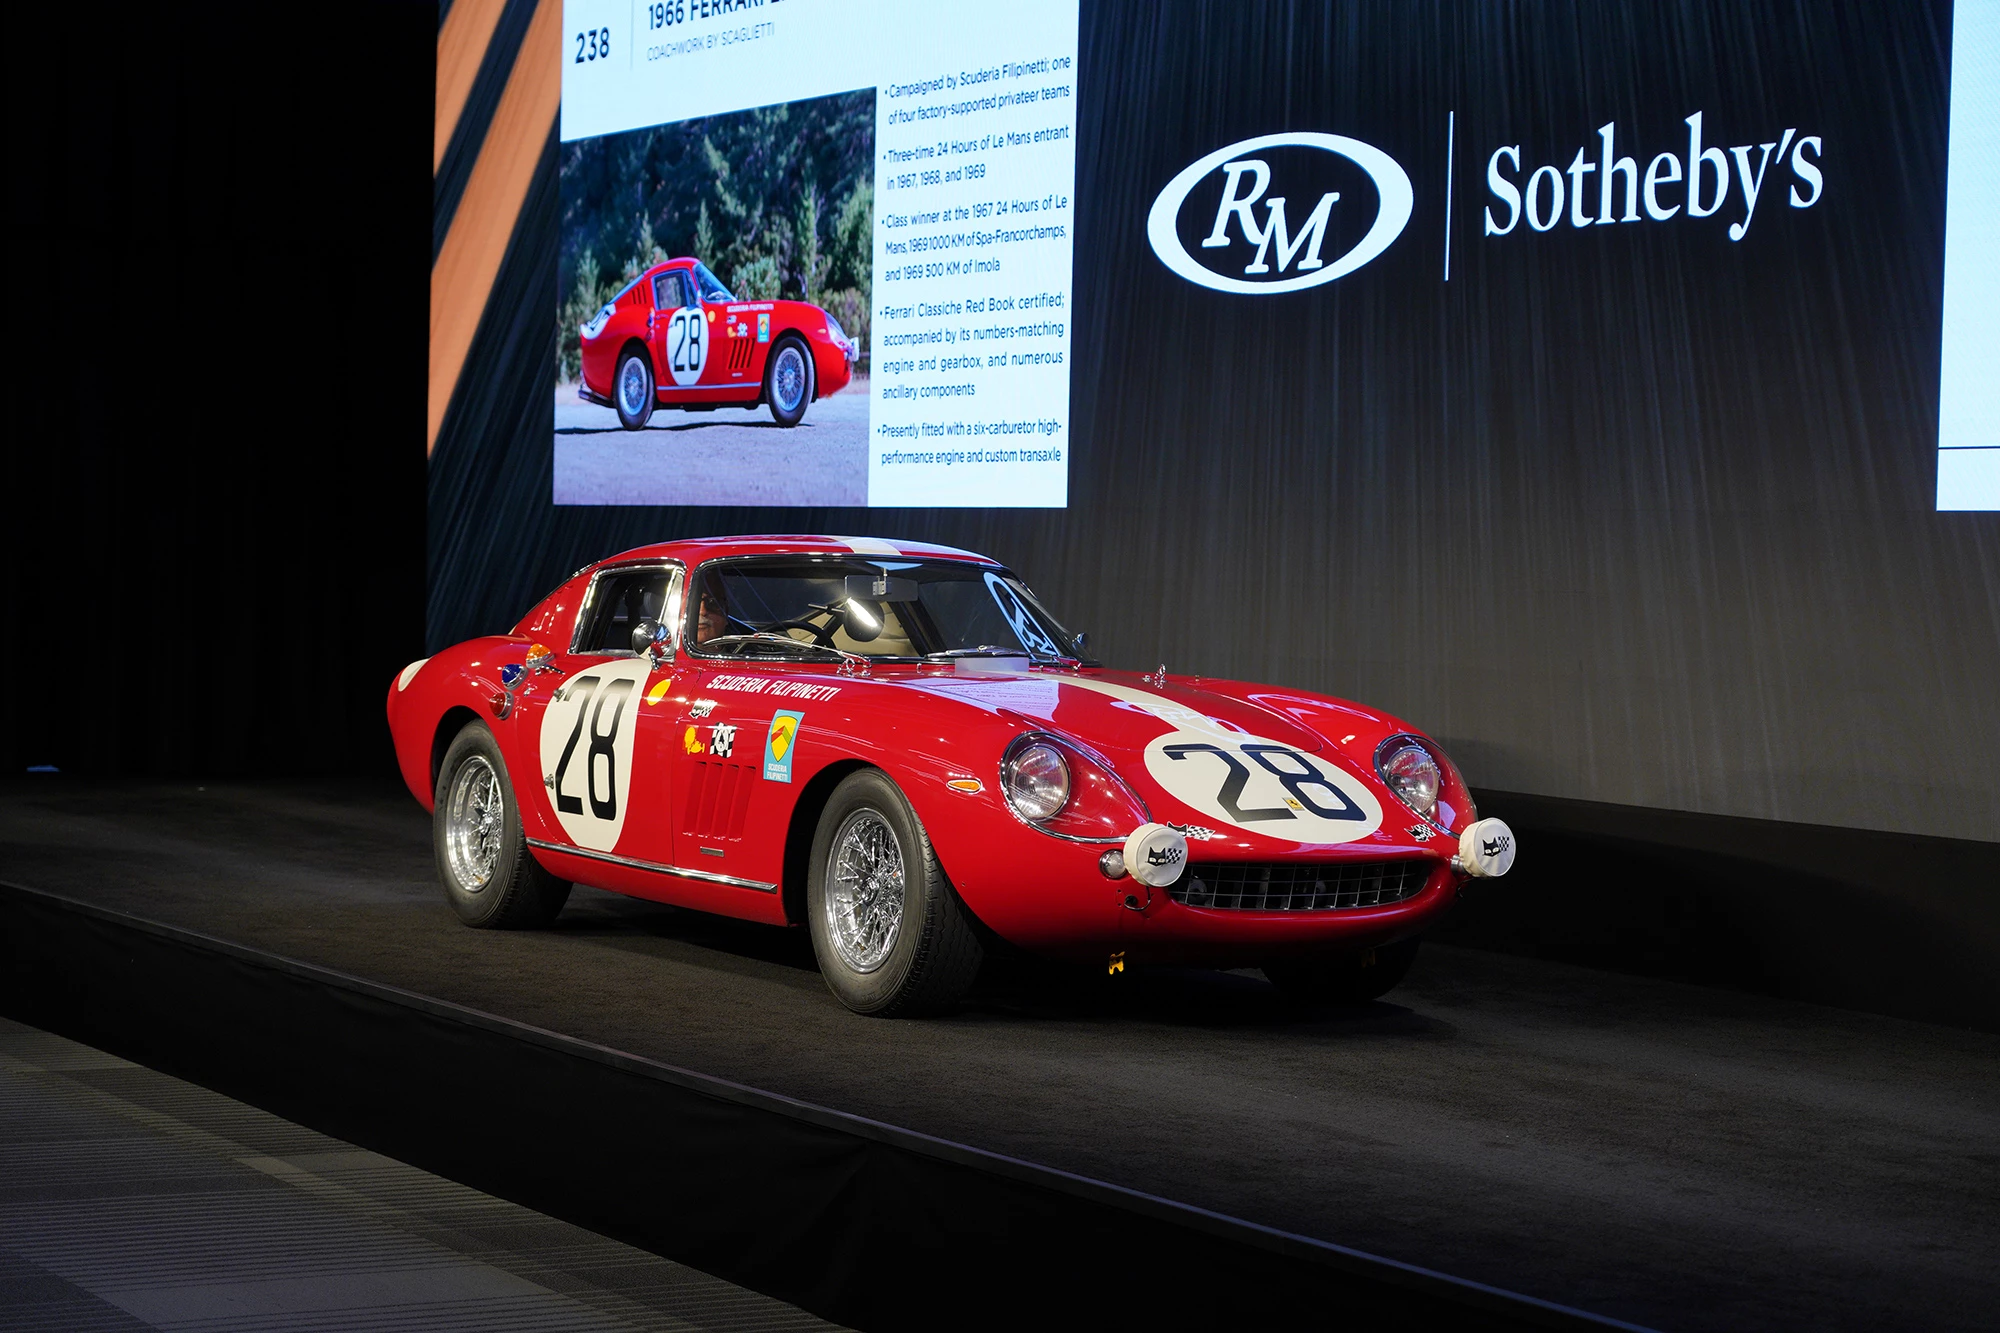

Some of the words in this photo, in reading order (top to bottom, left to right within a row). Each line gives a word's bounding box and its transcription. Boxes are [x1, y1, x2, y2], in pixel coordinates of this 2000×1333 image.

[648, 0, 685, 30] 1966
[690, 0, 767, 21] FERR
[575, 27, 610, 64] 238
[647, 35, 705, 61] COACHWORK
[706, 33, 720, 49] BY
[721, 21, 775, 46] SCAGLIETTI
[889, 74, 945, 98] Campaigned
[946, 73, 959, 91] by
[960, 66, 1000, 86] Scuderia
[1002, 57, 1050, 80] Filipinetti;
[1051, 56, 1071, 71] one
[888, 109, 898, 125] of
[899, 108, 916, 123] four
[917, 92, 997, 120] factory-supported
[998, 91, 1040, 111] privateer
[1041, 85, 1070, 101] teams
[888, 145, 935, 163] Three-time
[937, 141, 948, 157] 24
[951, 139, 978, 154] Hours
[980, 134, 991, 151] of
[992, 134, 1005, 149] Le
[1006, 131, 1031, 147] Mans
[1033, 124, 1069, 143] entrant
[886, 176, 895, 191] in
[897, 172, 918, 190] 1967,
[920, 169, 943, 186] 1968,
[944, 165, 962, 183] and
[964, 163, 986, 180] 1969
[1202, 158, 1341, 275] RM
[1484, 109, 1825, 242] Sotheby's
[886, 213, 908, 229] Class
[910, 210, 941, 226] winner
[942, 207, 952, 222] at
[954, 205, 970, 221] the
[972, 202, 994, 218] 1967
[996, 200, 1008, 216] 24
[1011, 198, 1039, 214] Hours
[1042, 194, 1053, 211] of
[1055, 194, 1068, 209] Le
[885, 241, 908, 255] Mans,
[909, 236, 928, 252] 1969
[929, 234, 951, 250] 1000
[951, 232, 965, 248] KM
[966, 231, 976, 247] of
[975, 224, 1067, 248] Spa-Francorchamps,
[885, 266, 901, 282] and
[903, 264, 924, 280] 1969
[925, 262, 945, 278] 500
[946, 260, 961, 276] KM
[962, 259, 973, 275] of
[974, 256, 1001, 273] Imola
[884, 303, 915, 320] Ferrari
[917, 299, 962, 317] Classiche
[965, 296, 985, 313] Red
[988, 295, 1015, 312] Book
[1018, 291, 1065, 309] certified;
[673, 314, 702, 372] 28
[883, 328, 943, 347] accompanied
[945, 327, 957, 345] by
[959, 326, 971, 342] its
[973, 320, 1065, 340] numbers-matching
[883, 357, 915, 375] engine
[918, 355, 937, 371] and
[940, 353, 984, 373] gearbox,
[987, 351, 1007, 368] and
[1011, 351, 1064, 366] numerous
[882, 383, 919, 401] ancillary
[919, 382, 976, 399] components
[881, 421, 920, 440] Presently
[921, 421, 945, 437] fitted
[946, 421, 965, 436] with
[966, 426, 972, 436] a
[973, 419, 1036, 436] six-carburetor
[1037, 418, 1062, 436] high-
[881, 449, 934, 467] performance
[935, 448, 965, 466] engine
[966, 447, 983, 463] and
[984, 448, 1018, 463] custom
[1019, 446, 1062, 462] transaxle
[706, 674, 765, 694] SCUDERIA
[764, 680, 842, 702] FILIPINETTI
[555, 675, 636, 822] 28
[1162, 742, 1368, 823] 28
